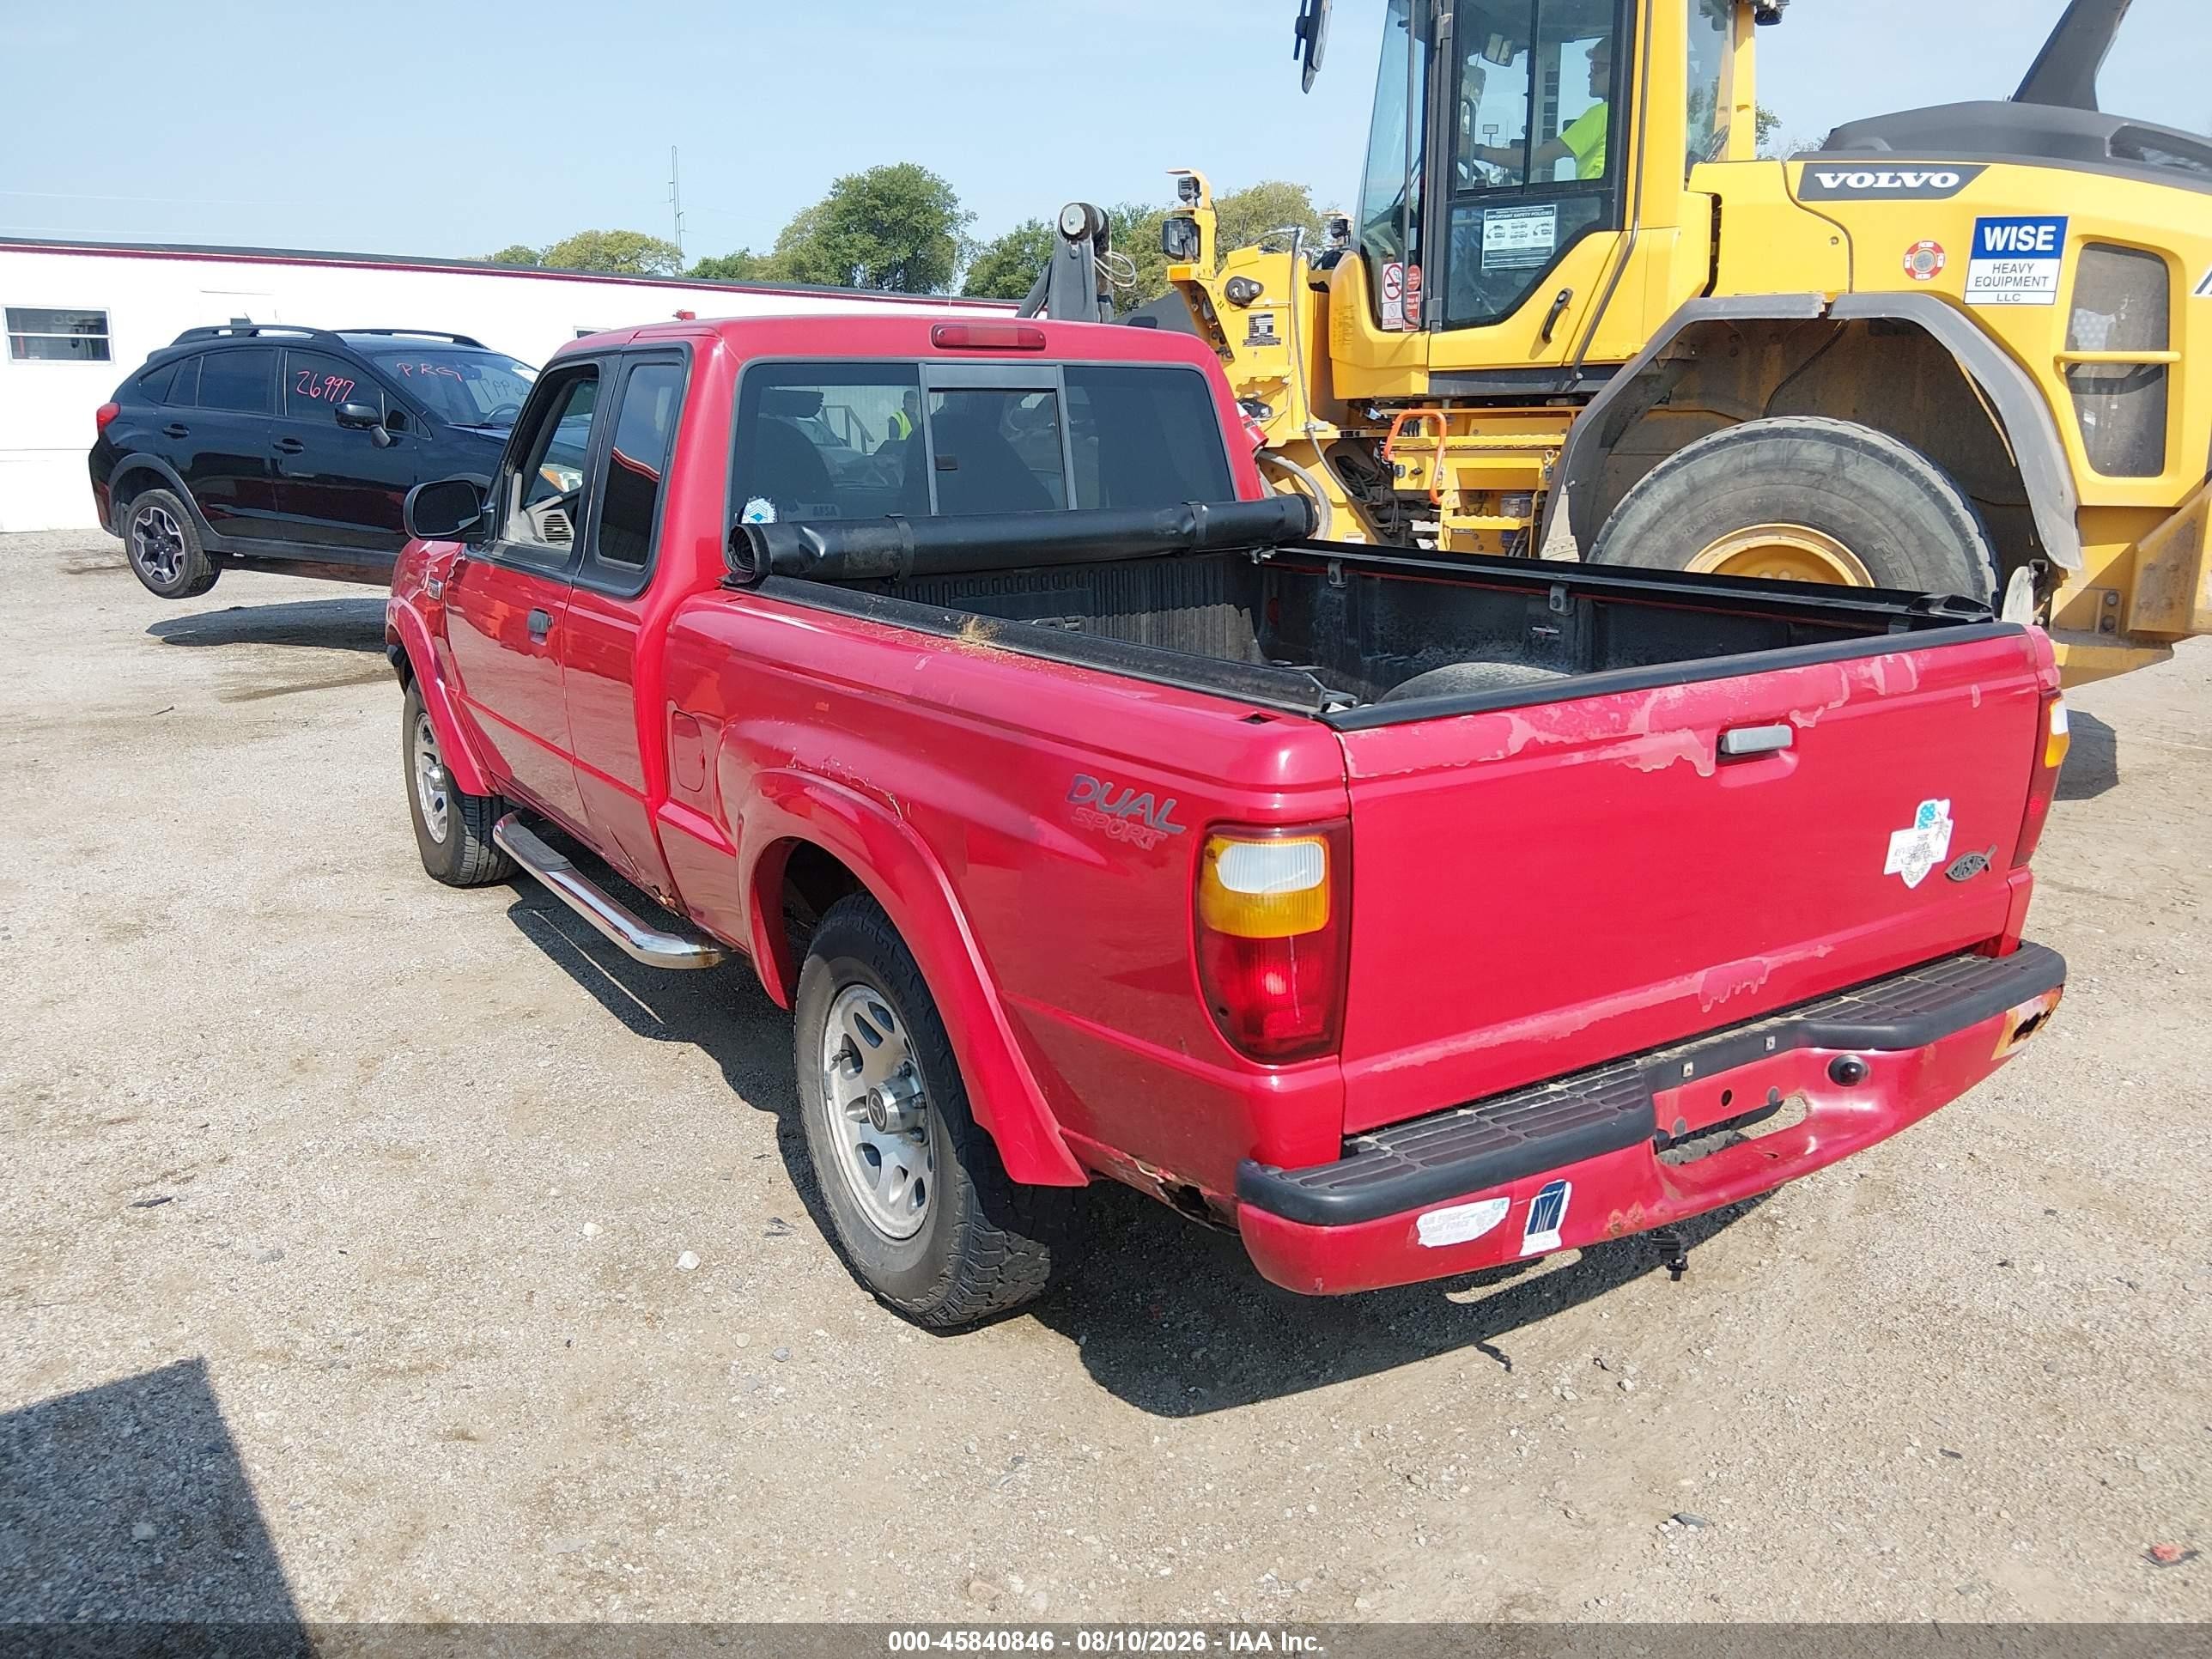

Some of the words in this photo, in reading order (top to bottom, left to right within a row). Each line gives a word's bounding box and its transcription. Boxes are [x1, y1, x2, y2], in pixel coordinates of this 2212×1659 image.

[1814, 172, 1960, 189] VOLVO
[1984, 225, 2057, 252] WISE
[1991, 263, 2034, 274] HEAVY
[1974, 276, 2050, 287] EQUIPMENT
[1996, 293, 2021, 302] LLC
[296, 370, 355, 403] 26997
[1065, 773, 1186, 834] DUAL
[1071, 806, 1168, 851] SPORT
